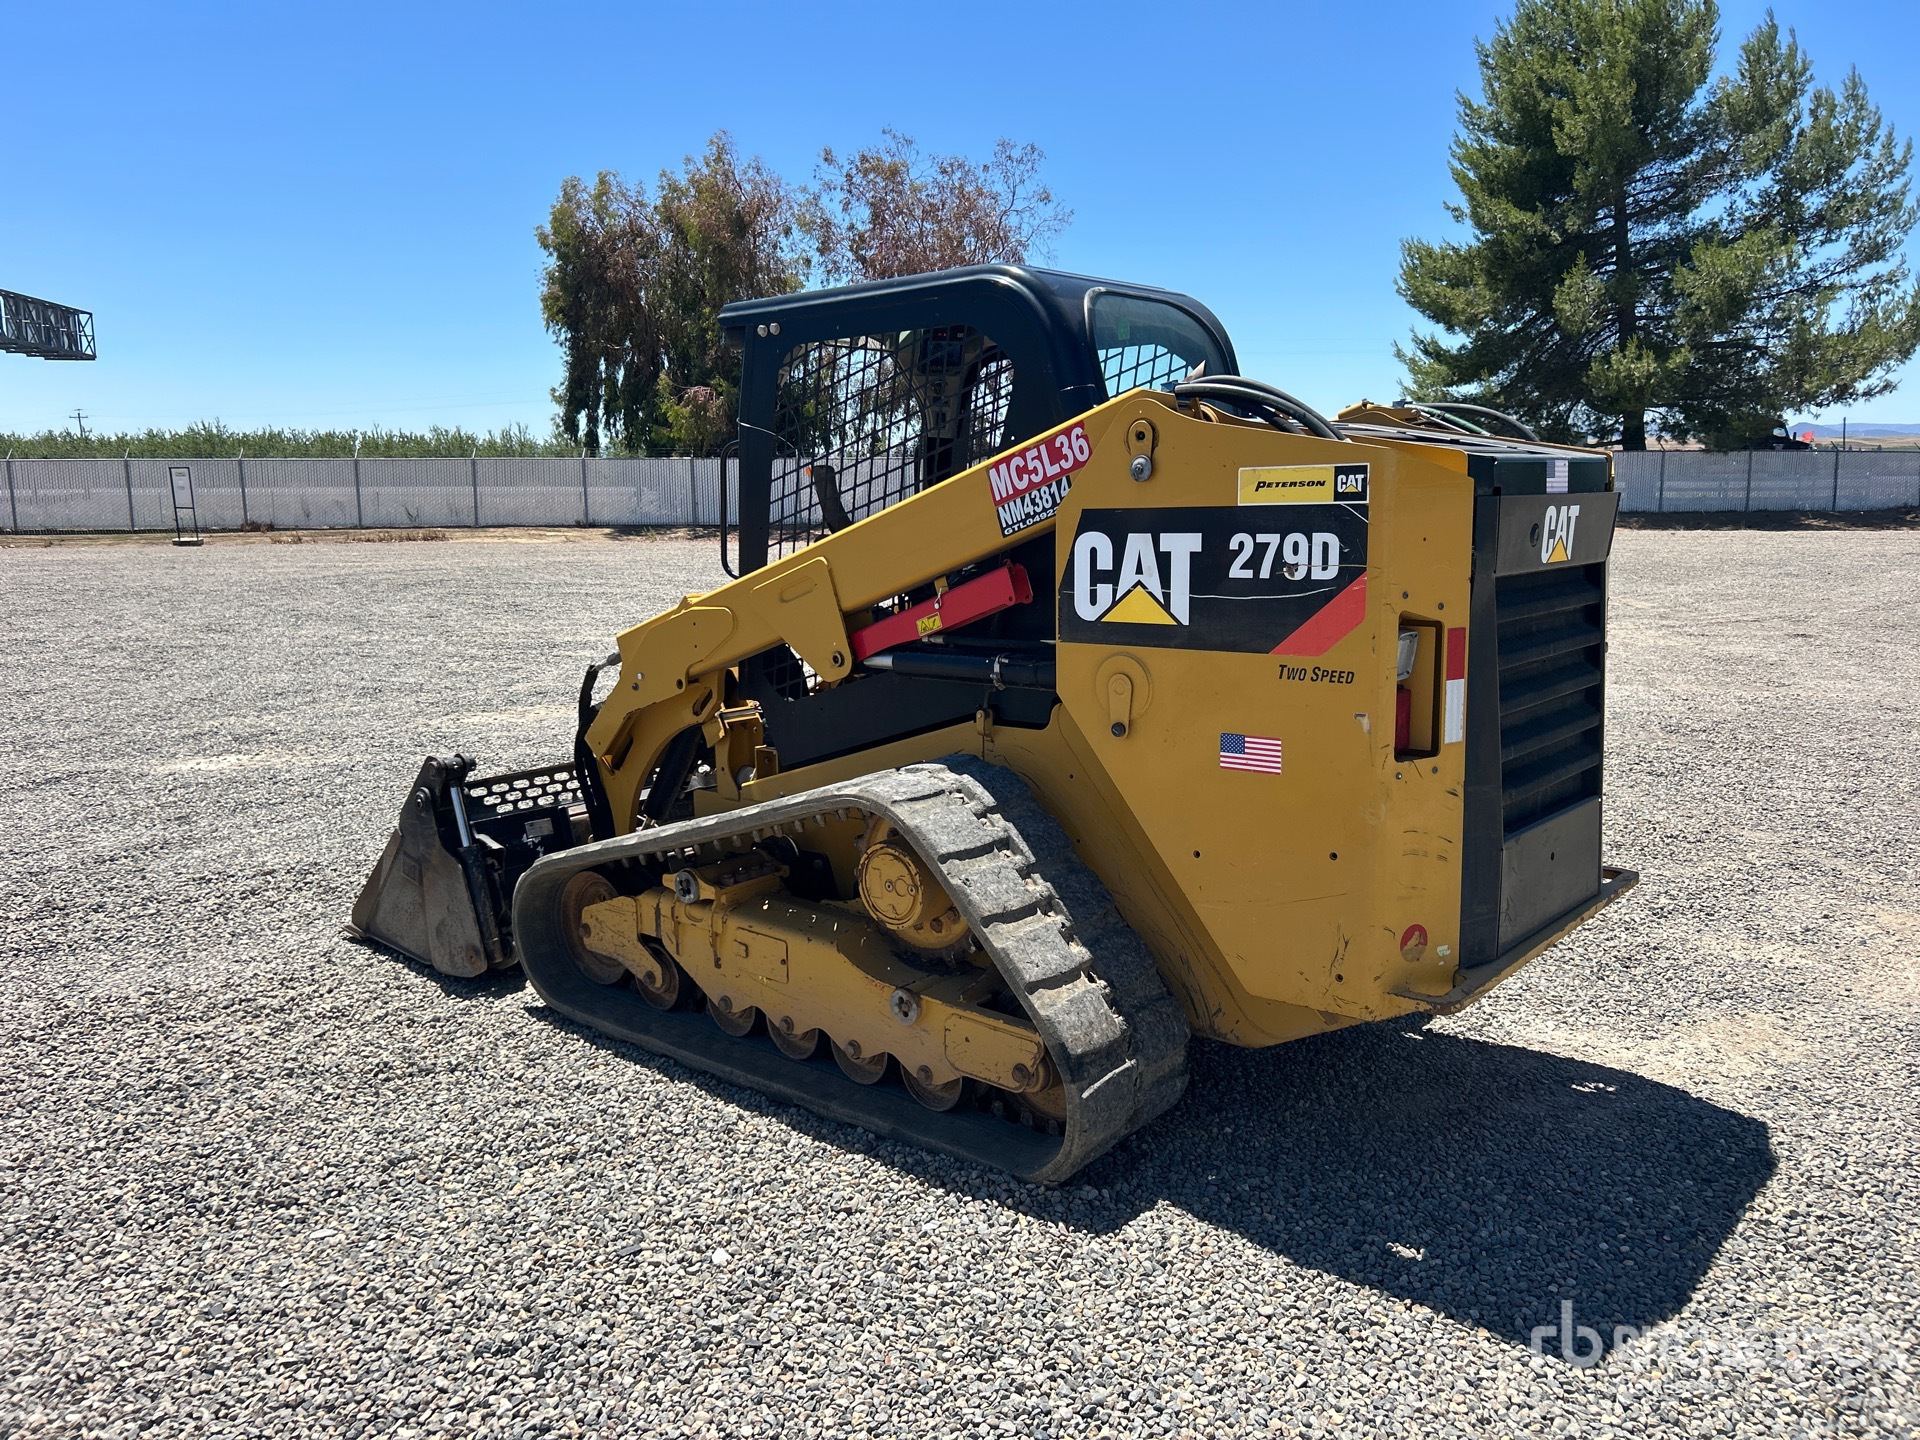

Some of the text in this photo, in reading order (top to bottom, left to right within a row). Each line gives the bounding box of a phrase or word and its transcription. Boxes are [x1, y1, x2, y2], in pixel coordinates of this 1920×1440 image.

[988, 426, 1091, 501] MC5L36
[1254, 480, 1327, 492] PETERSON
[1337, 474, 1365, 493] CAT
[997, 476, 1071, 528] NM43814
[1228, 532, 1340, 580] 279D
[1541, 504, 1580, 564] CAT
[1074, 531, 1202, 626] CAT
